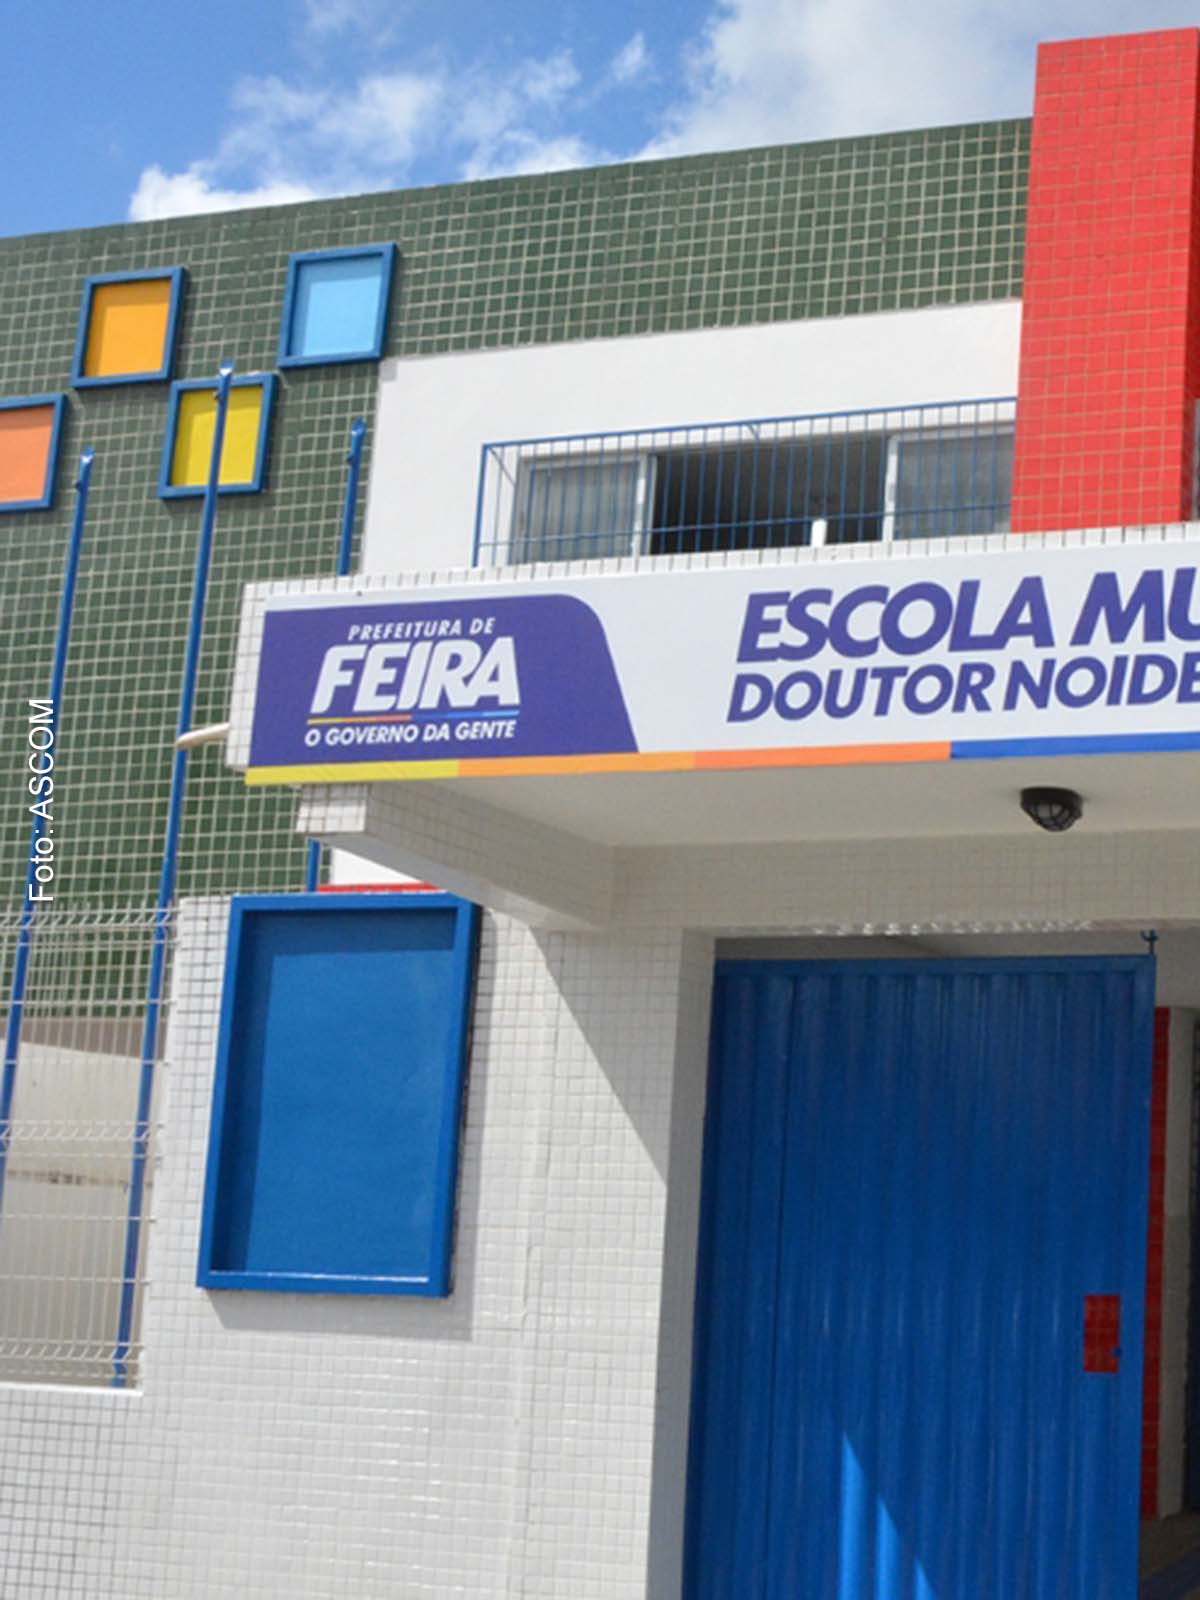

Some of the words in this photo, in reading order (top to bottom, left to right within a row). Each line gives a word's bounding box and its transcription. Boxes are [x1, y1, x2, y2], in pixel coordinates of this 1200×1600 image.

[347, 619, 463, 641] PREFEITURA
[468, 617, 495, 635] DE
[736, 574, 1055, 663] ESCOLA
[309, 635, 521, 714] FEIRA
[725, 659, 998, 723] DOUTOR
[304, 730, 321, 747] O
[325, 723, 418, 746] GOVERNO
[422, 722, 451, 743] DA
[455, 719, 516, 741] GENTE
